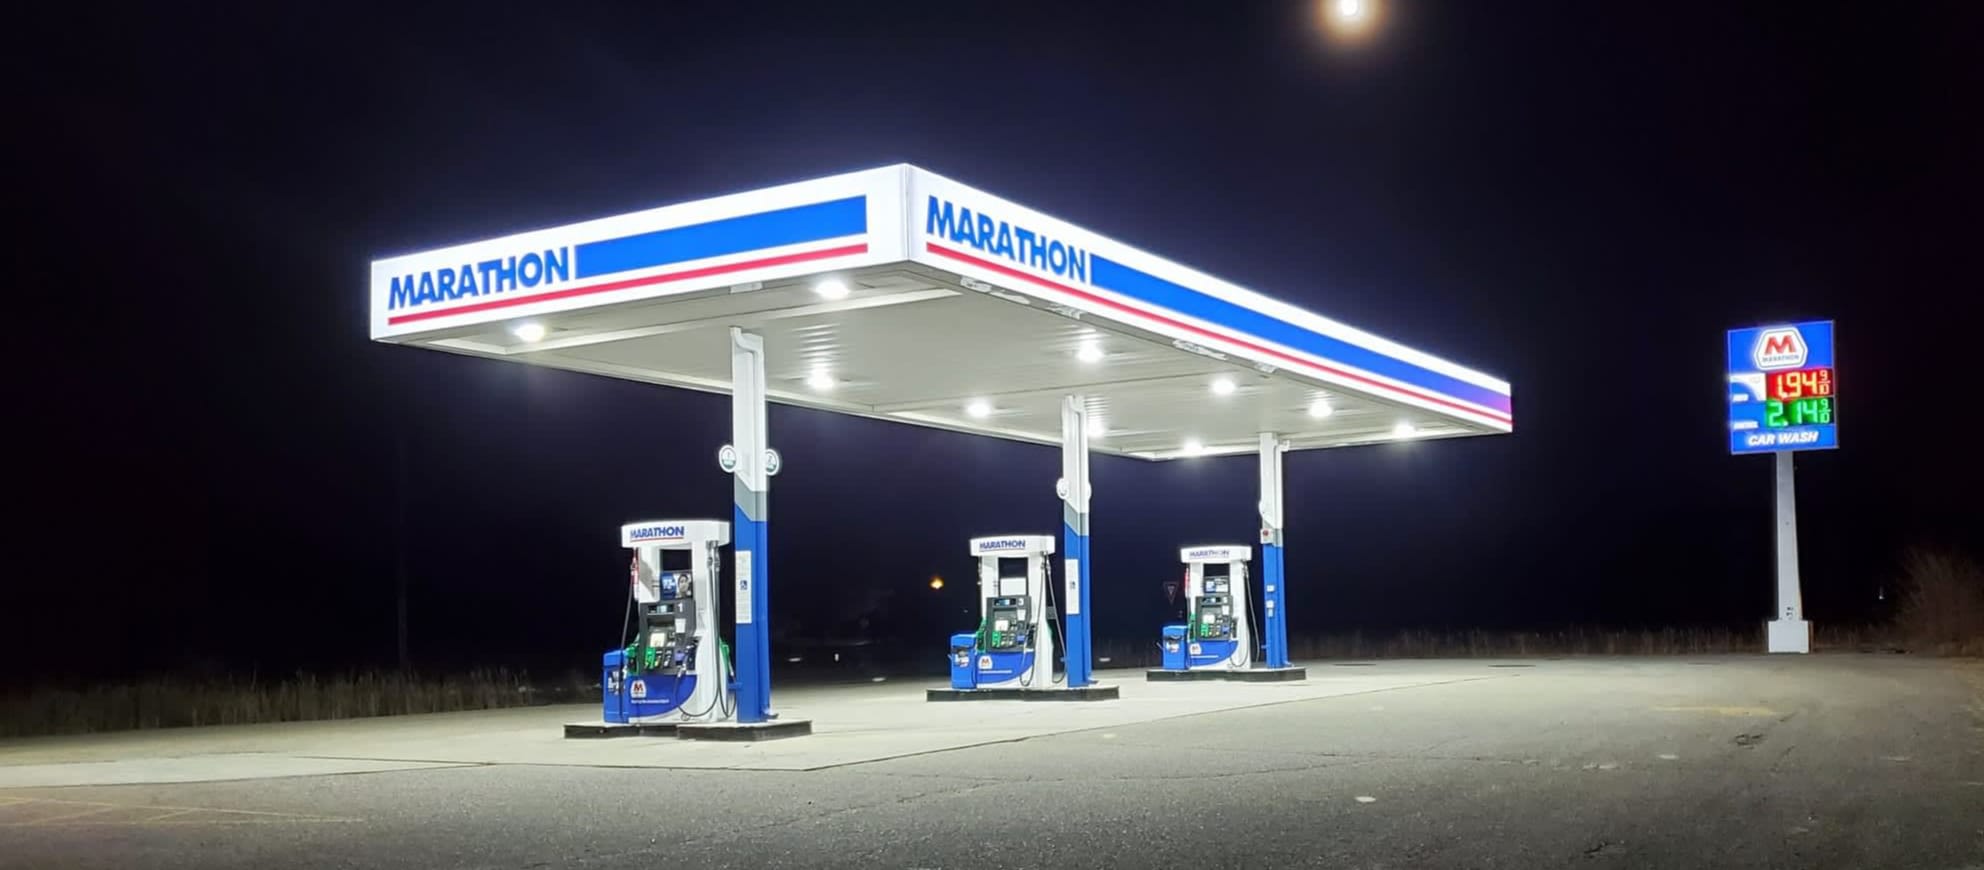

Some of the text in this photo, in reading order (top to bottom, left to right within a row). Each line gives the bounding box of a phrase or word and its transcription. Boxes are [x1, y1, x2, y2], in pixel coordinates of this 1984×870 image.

[926, 195, 1085, 283] MARATHON
[388, 246, 569, 310] MARATHON
[1764, 334, 1797, 355] M
[1777, 372, 1818, 399] 1.94
[1768, 400, 1818, 427] 2.14
[1748, 431, 1819, 446] CAR WASH
[630, 526, 685, 538] MARATHON
[980, 540, 1026, 549] MARATHON
